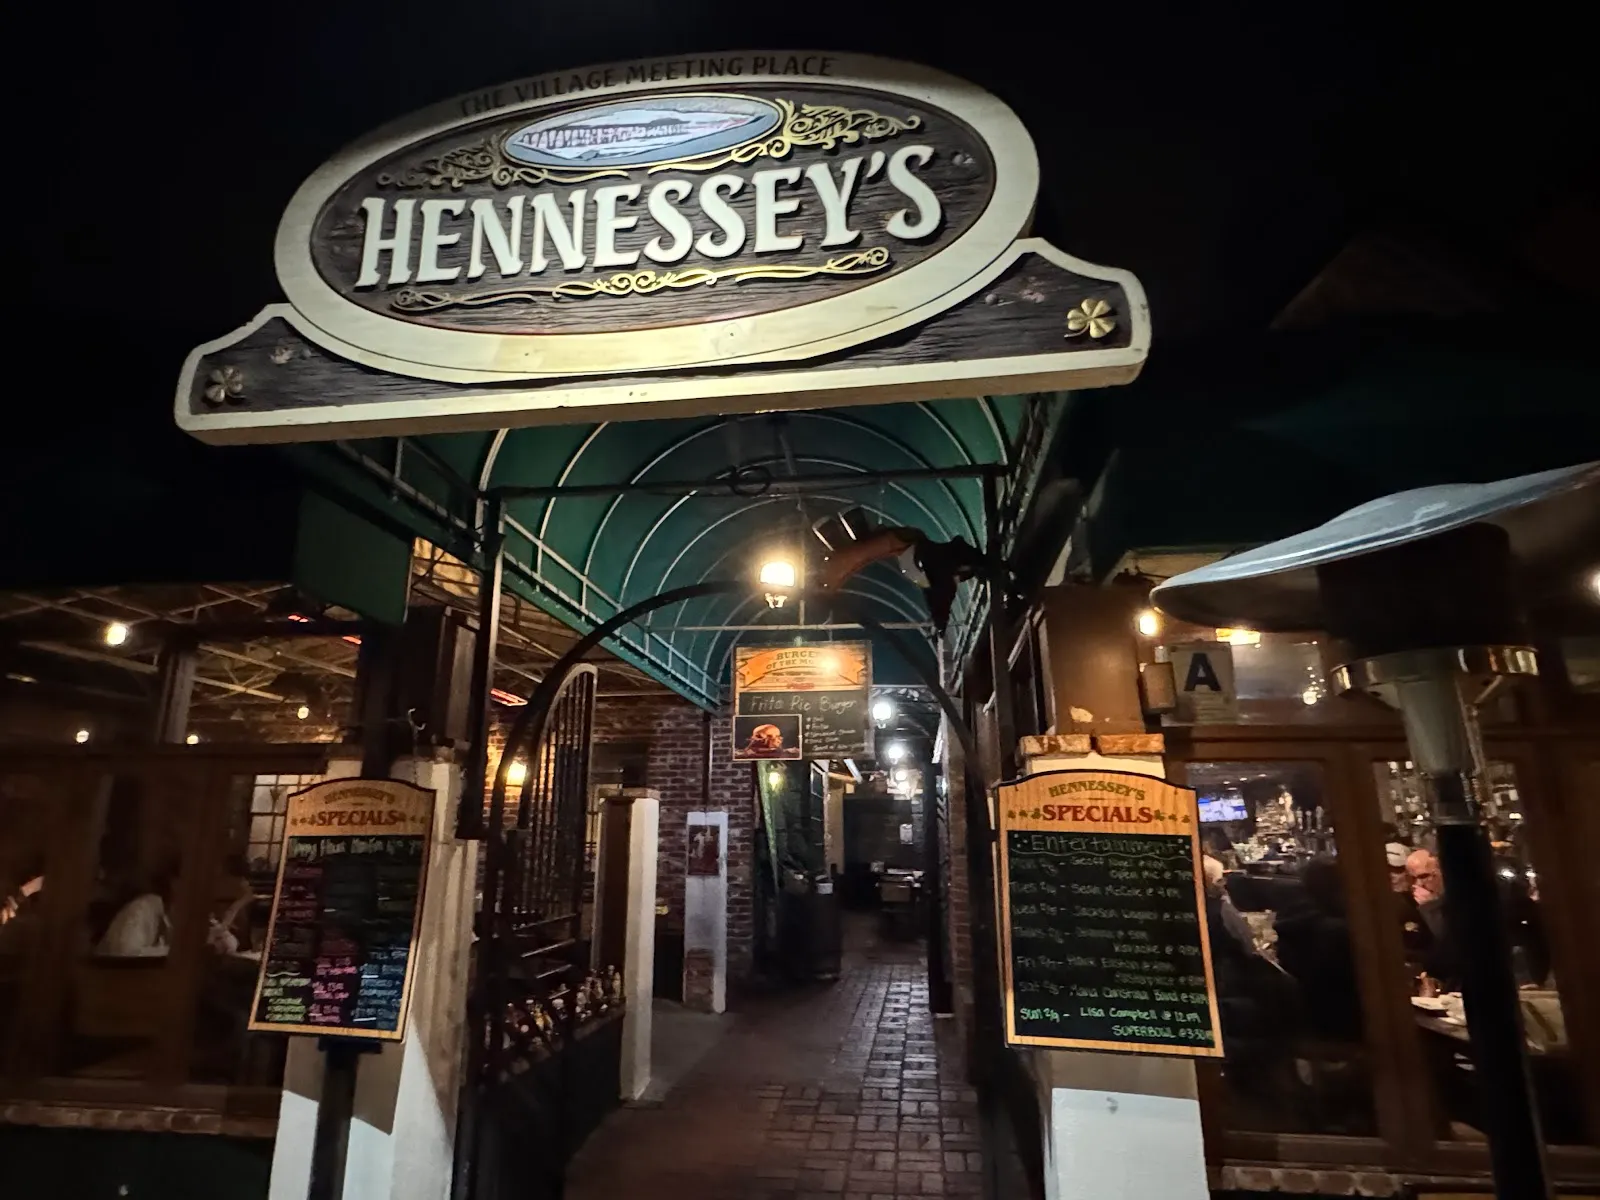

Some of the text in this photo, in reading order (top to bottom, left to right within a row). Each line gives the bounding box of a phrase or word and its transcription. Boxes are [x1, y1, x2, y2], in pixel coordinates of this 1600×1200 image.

[459, 55, 835, 118] THE VILLAGE MEETING PLACE
[354, 143, 942, 292] HENNESSEY'S
[776, 650, 821, 660] BURGE
[1184, 653, 1221, 691] A
[1047, 780, 1146, 800] HENNESSEY'S
[316, 810, 400, 826] SPECIALS
[1042, 804, 1153, 823] SPECIALS
[1109, 1006, 1158, 1021] Campbell
[1162, 1009, 1172, 1021] @
